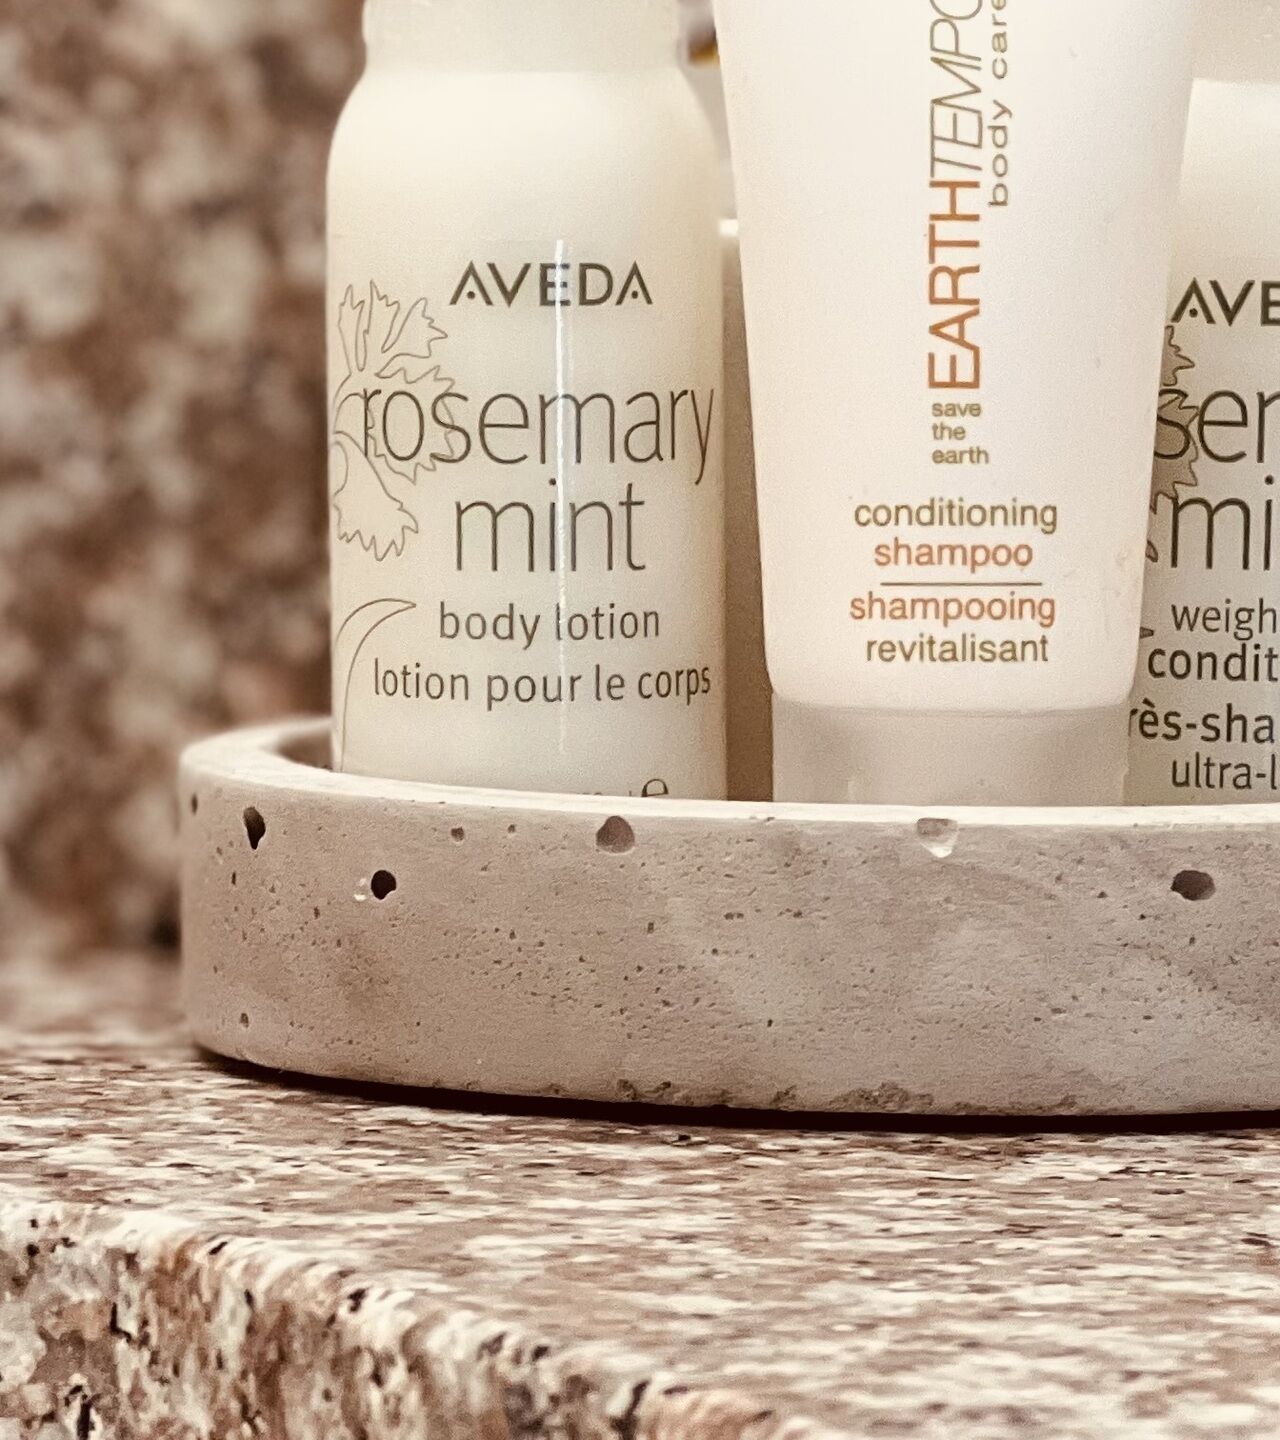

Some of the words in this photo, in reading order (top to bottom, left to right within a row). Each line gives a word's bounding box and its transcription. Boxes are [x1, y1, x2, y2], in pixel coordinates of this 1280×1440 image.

[988, 99, 1013, 207] body
[449, 261, 654, 307] AVEDA
[931, 402, 982, 418] save
[362, 387, 715, 486] rosemary
[931, 421, 966, 441] the
[931, 446, 990, 465] earth
[455, 478, 646, 573] mint
[853, 496, 1058, 535] conditioning
[873, 536, 1034, 574] shampoo
[439, 600, 541, 651] body
[554, 602, 660, 641] lotion
[849, 590, 1056, 628] shampooing
[866, 632, 1049, 662] revitalisant
[373, 657, 470, 701] lotion
[486, 672, 583, 712] pour
[594, 663, 626, 702] le
[637, 666, 712, 707] corps
